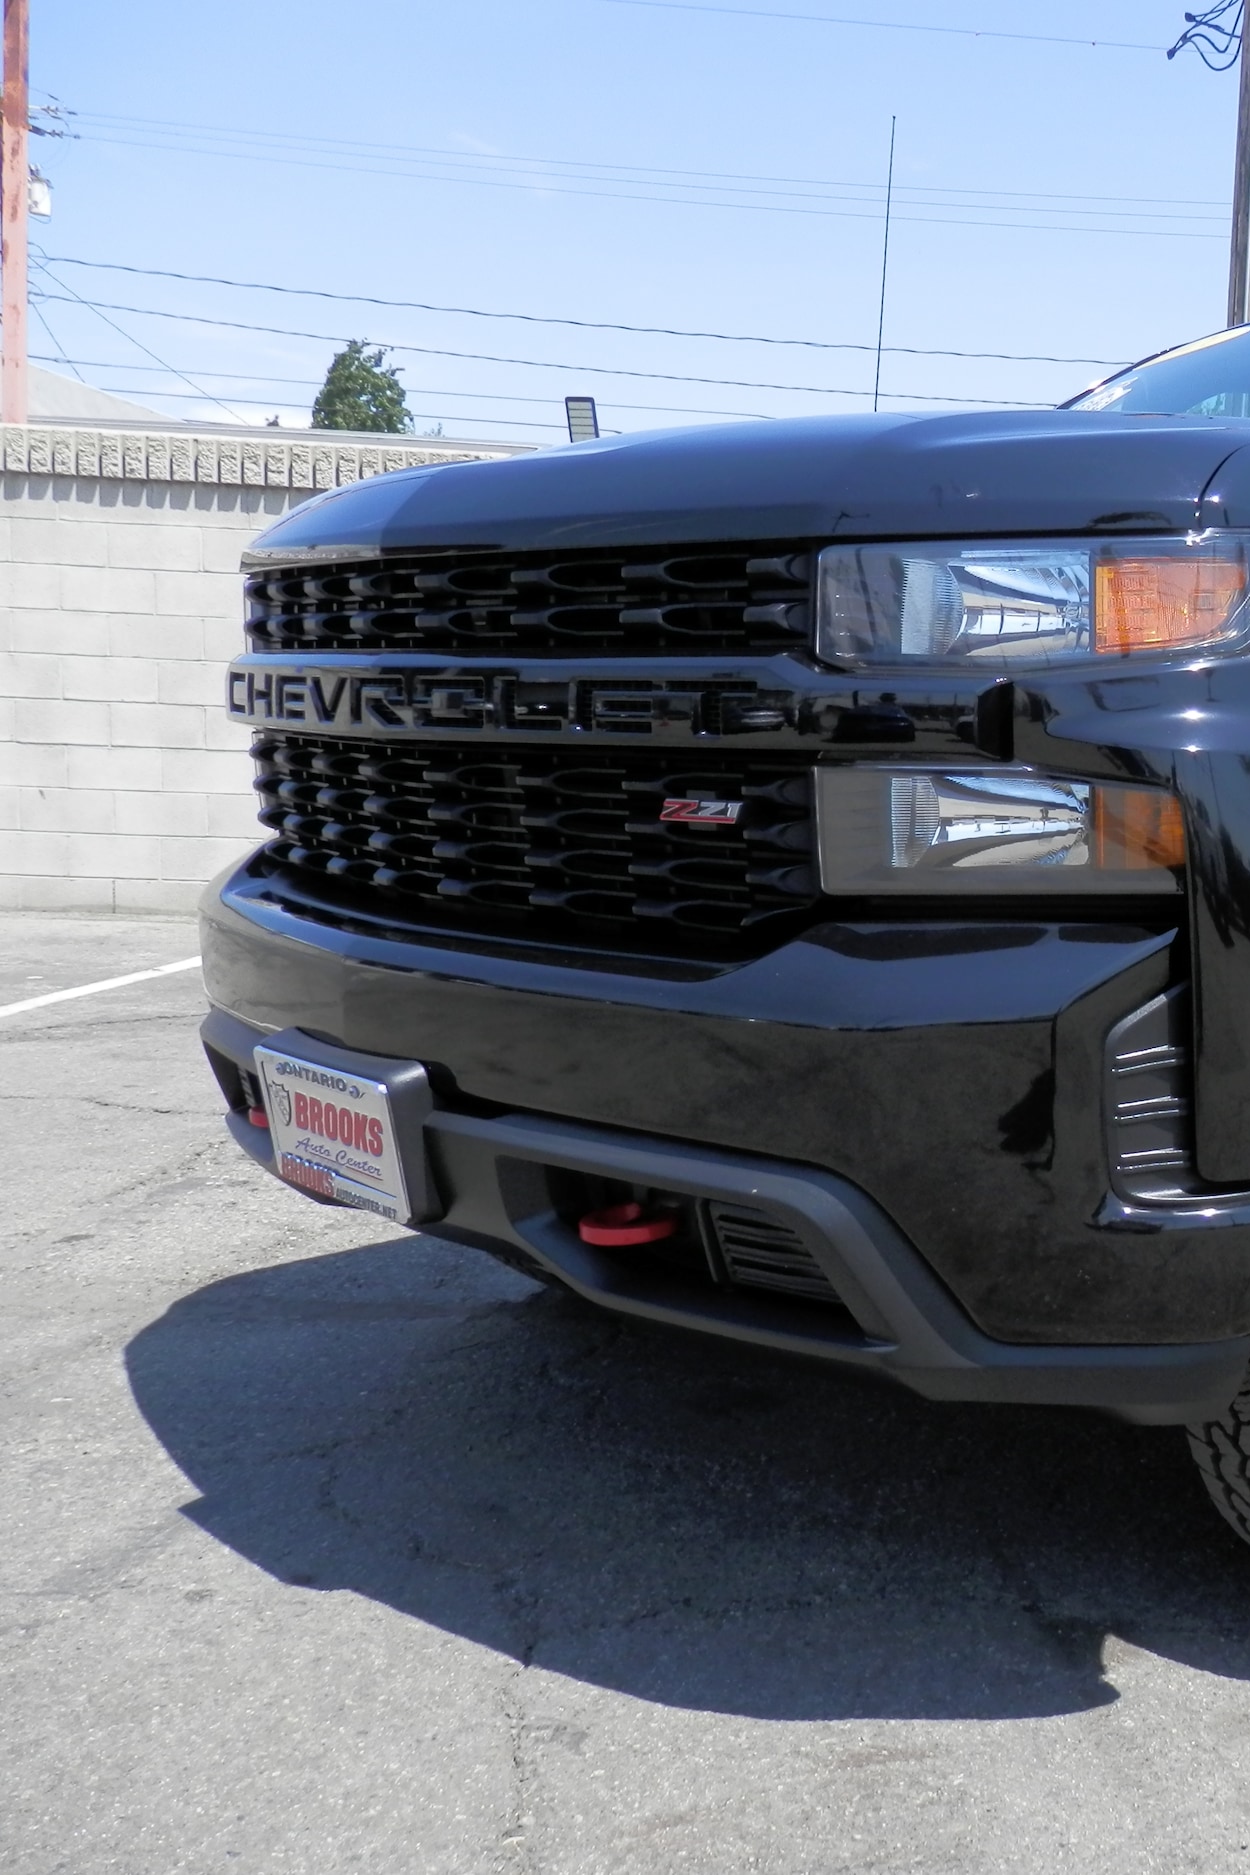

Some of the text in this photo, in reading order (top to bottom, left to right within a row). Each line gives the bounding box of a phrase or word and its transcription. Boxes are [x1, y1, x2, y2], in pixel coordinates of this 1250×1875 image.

[229, 671, 758, 737] CHEVROLET
[660, 798, 743, 824] Z71
[284, 1061, 347, 1092] ONTARIO
[294, 1091, 384, 1158] BROOKS
[294, 1136, 383, 1177] Auto Center
